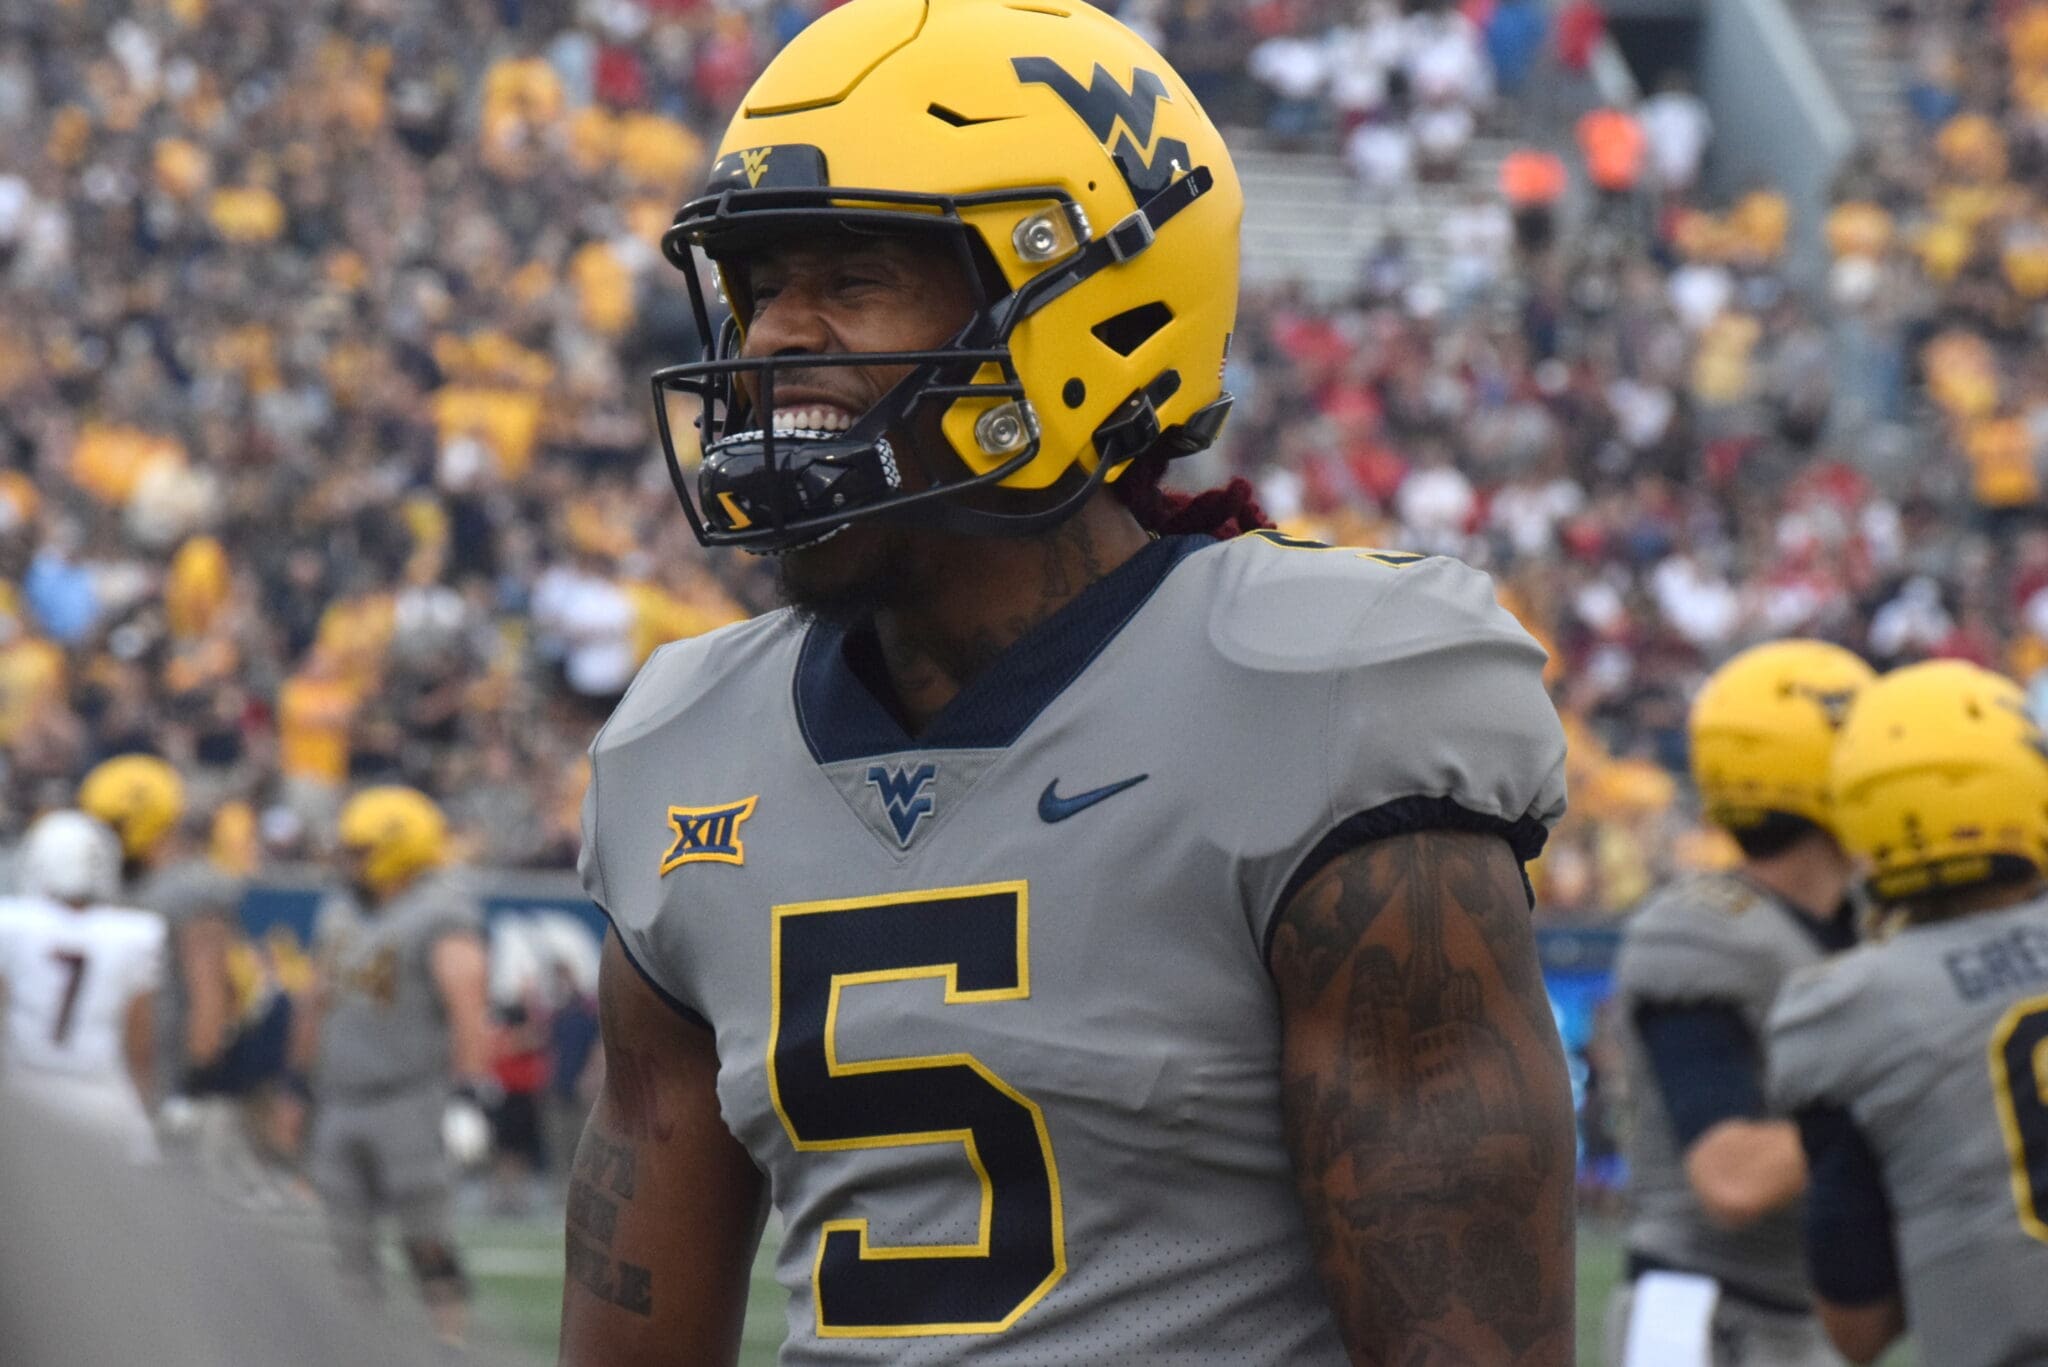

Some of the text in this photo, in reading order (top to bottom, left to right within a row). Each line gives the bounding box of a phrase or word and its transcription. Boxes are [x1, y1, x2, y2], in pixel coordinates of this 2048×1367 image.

[663, 800, 754, 865] XII
[48, 947, 88, 1047] 7
[766, 879, 1067, 1338] 5
